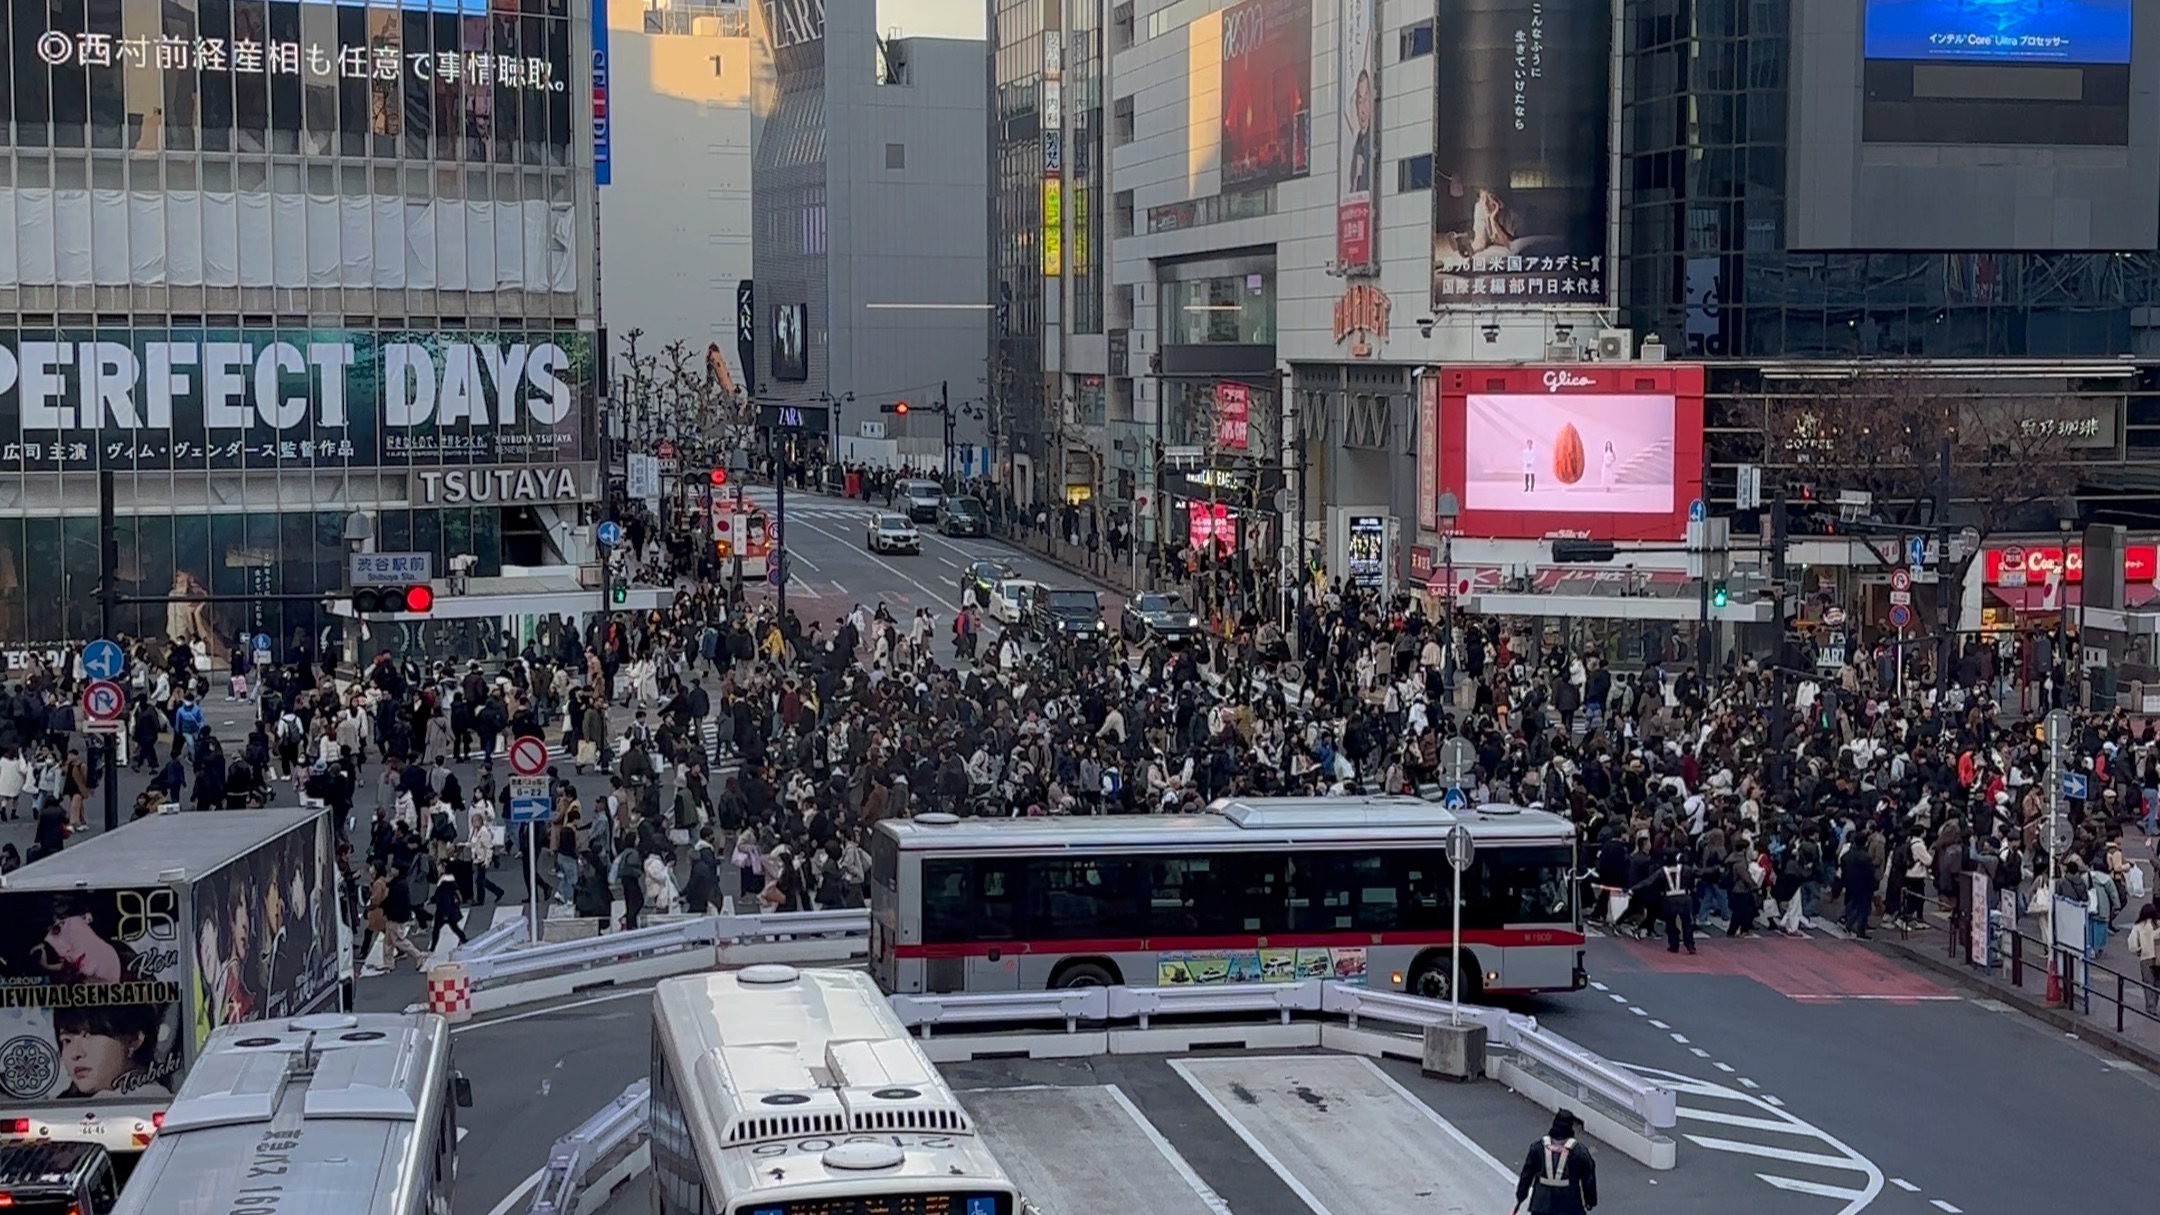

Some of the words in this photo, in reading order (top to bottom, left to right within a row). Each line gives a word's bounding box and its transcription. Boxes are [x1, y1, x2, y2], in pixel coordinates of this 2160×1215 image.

[1531, 3, 1542, 78] こんなふうに
[1967, 33, 1991, 45] Core
[1514, 30, 1526, 130] 生きていけたなら
[1441, 277, 1601, 296] 国際長編部門日本代表
[740, 289, 752, 341] ZARA
[385, 342, 571, 427] DAYS
[1543, 370, 1597, 393] Glico
[778, 407, 804, 427] ZARA
[419, 468, 577, 502] TSUTAYA
[357, 557, 425, 572] 渋谷駅前
[368, 573, 398, 582] Shibuya
[0, 984, 72, 1008] EVIVAL
[72, 981, 180, 1007] SENSATION
[752, 1134, 954, 1159] 2105
